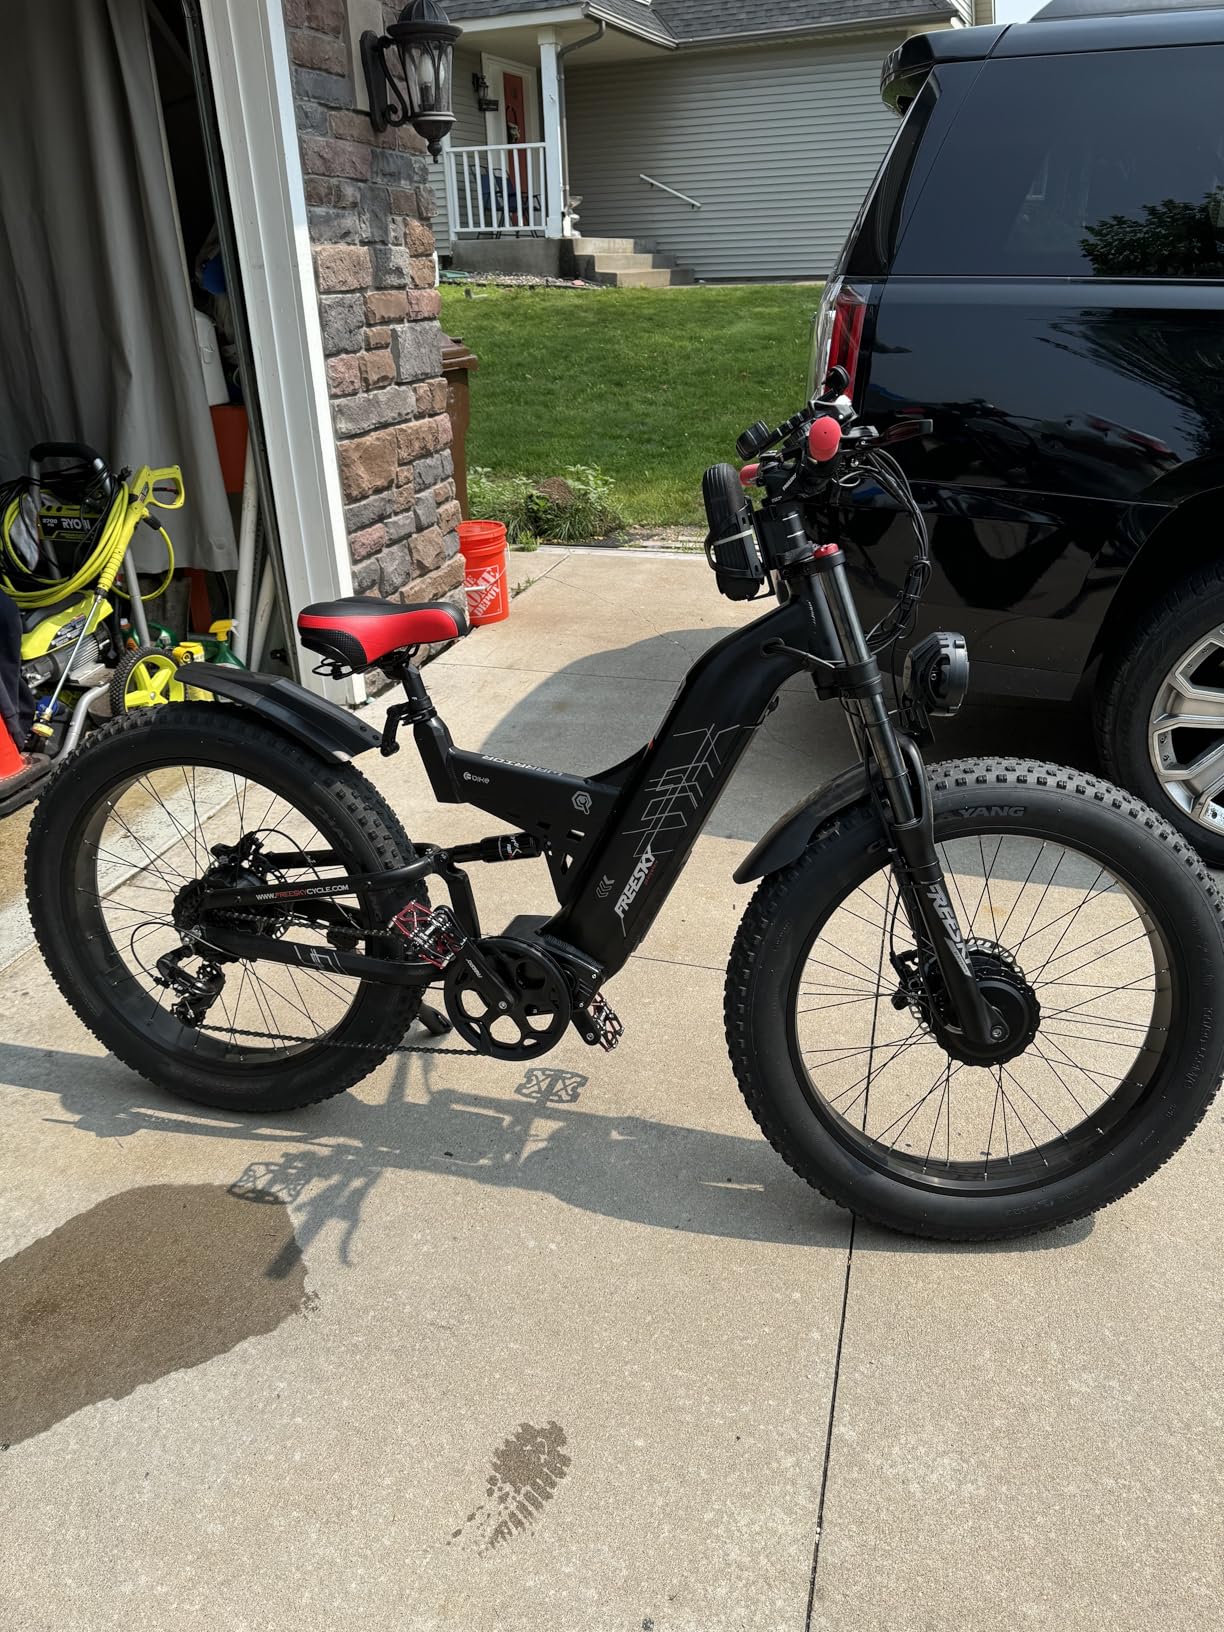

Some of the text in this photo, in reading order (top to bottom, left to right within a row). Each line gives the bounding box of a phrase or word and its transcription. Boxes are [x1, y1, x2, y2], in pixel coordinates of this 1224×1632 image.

[473, 584, 500, 616] DEPOT
[255, 884, 350, 901] WWW.FREESKYCYCLE.COM
[613, 843, 656, 918] FREESKY
